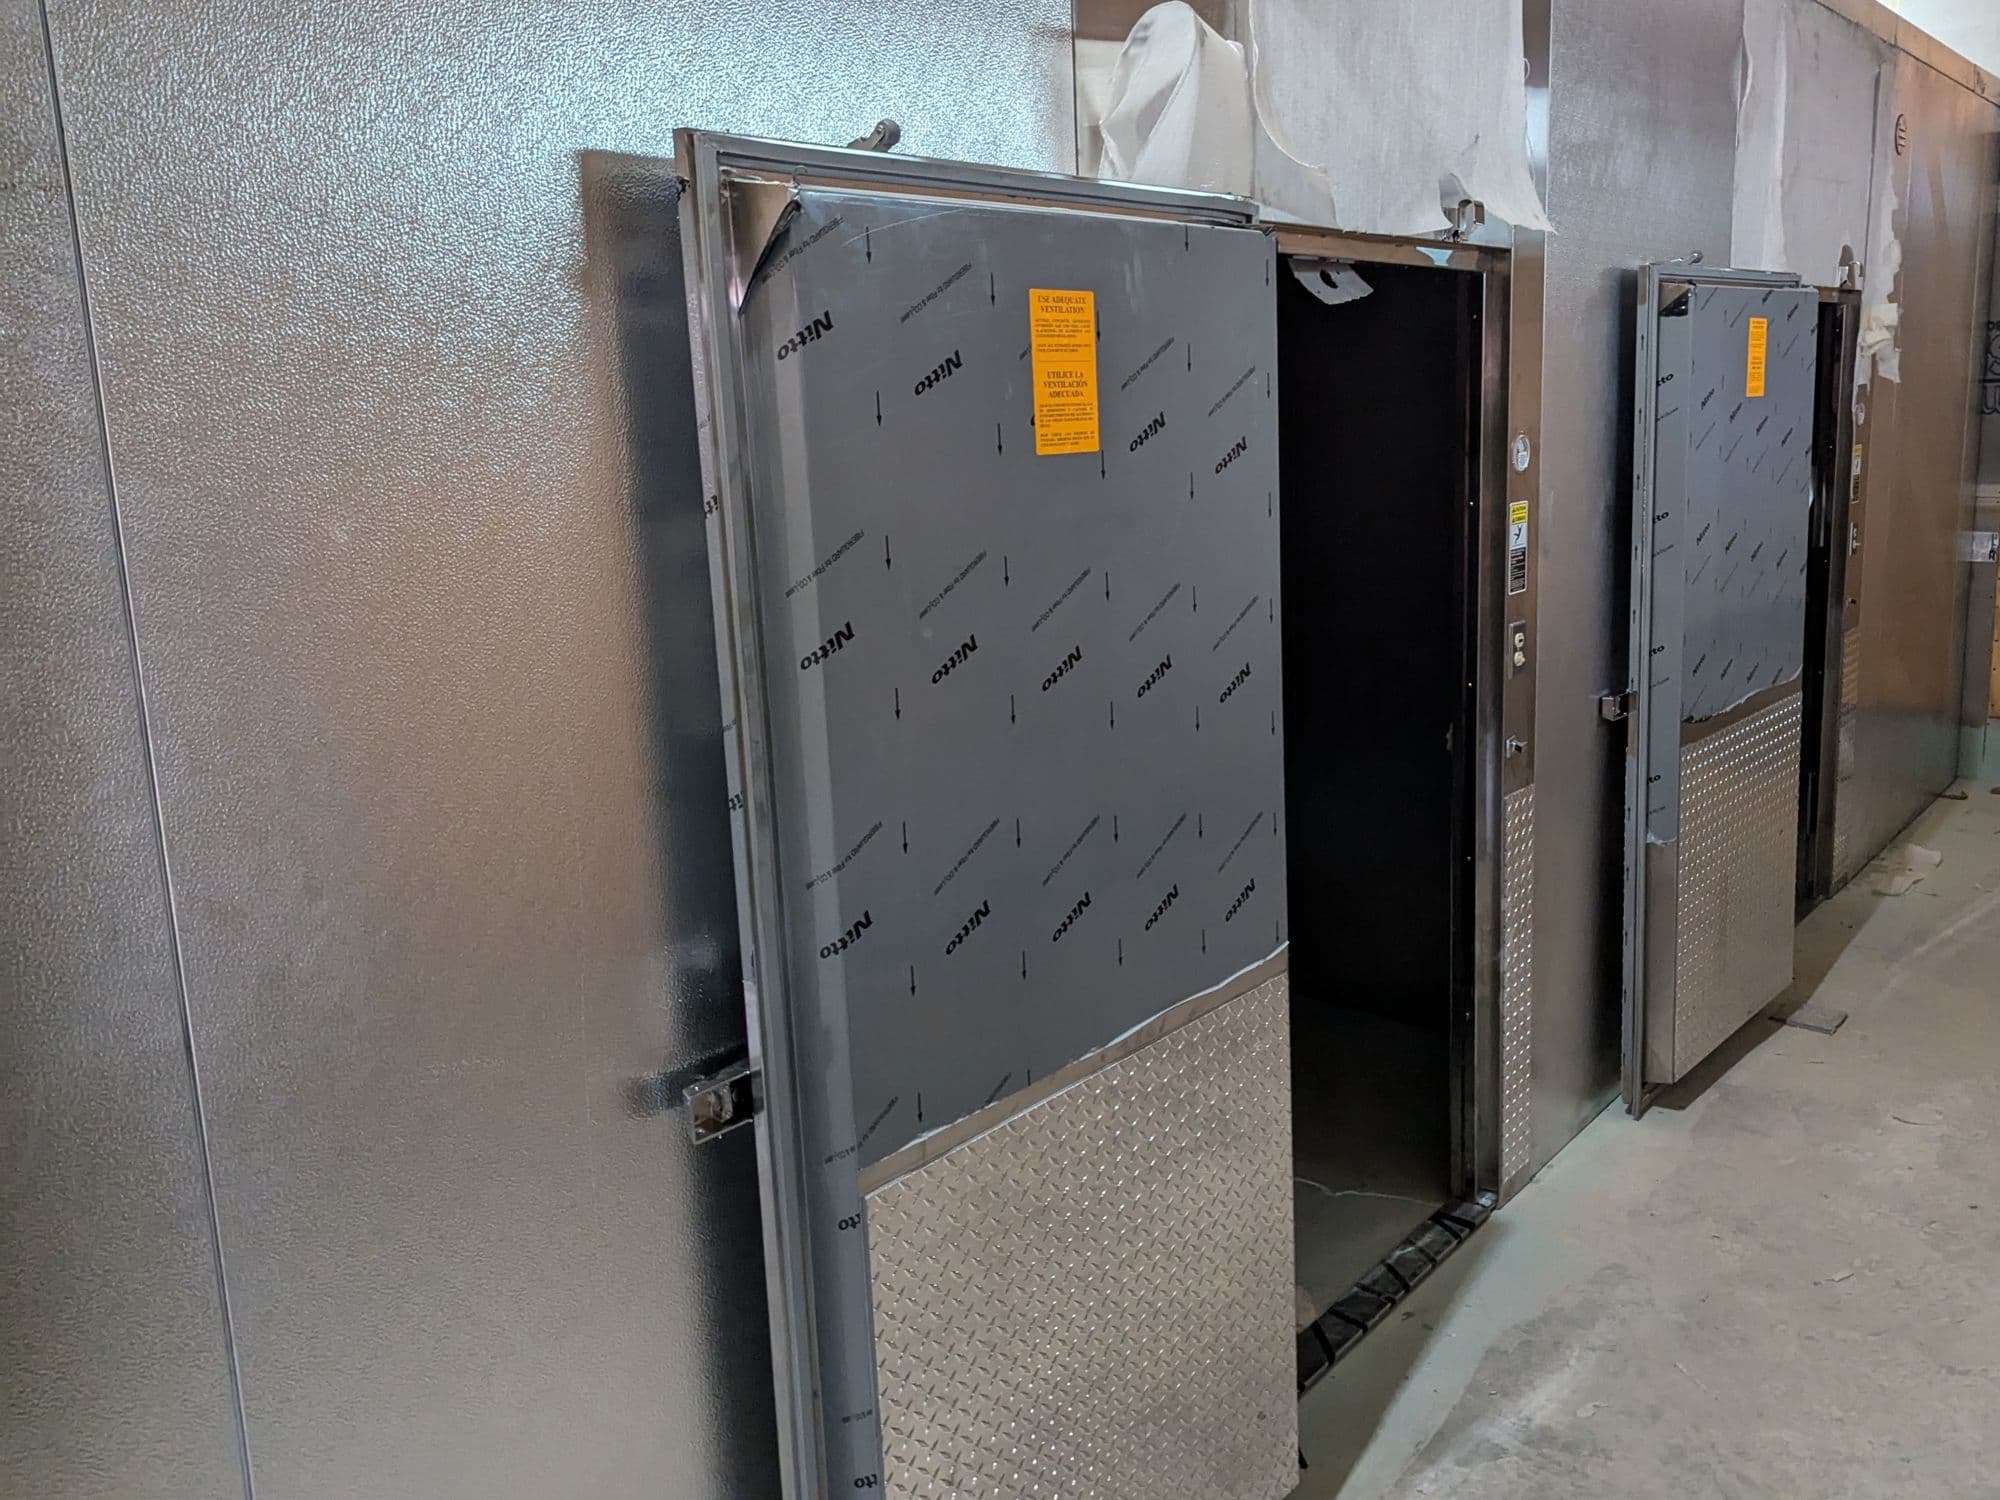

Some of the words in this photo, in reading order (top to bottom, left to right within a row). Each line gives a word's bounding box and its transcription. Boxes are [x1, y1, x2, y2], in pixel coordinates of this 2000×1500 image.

[1040, 305, 1085, 314] VENTILATION
[1052, 296, 1086, 305] ADEQUATE
[777, 310, 833, 360] Nitto
[914, 350, 963, 395] Nitto
[1129, 411, 1166, 452] Nitto
[1215, 435, 1248, 474] Nitto
[800, 621, 855, 670] Nitto
[931, 634, 978, 684] Nitto
[1042, 645, 1082, 691] Nitto
[1137, 654, 1172, 698] Nitto
[1219, 662, 1251, 703] Nitto
[1053, 891, 1092, 942] Nitto
[1145, 884, 1179, 931] Nitto
[1225, 878, 1255, 922] Nitto
[819, 910, 873, 958] Nitto
[945, 900, 991, 955] Nitto
